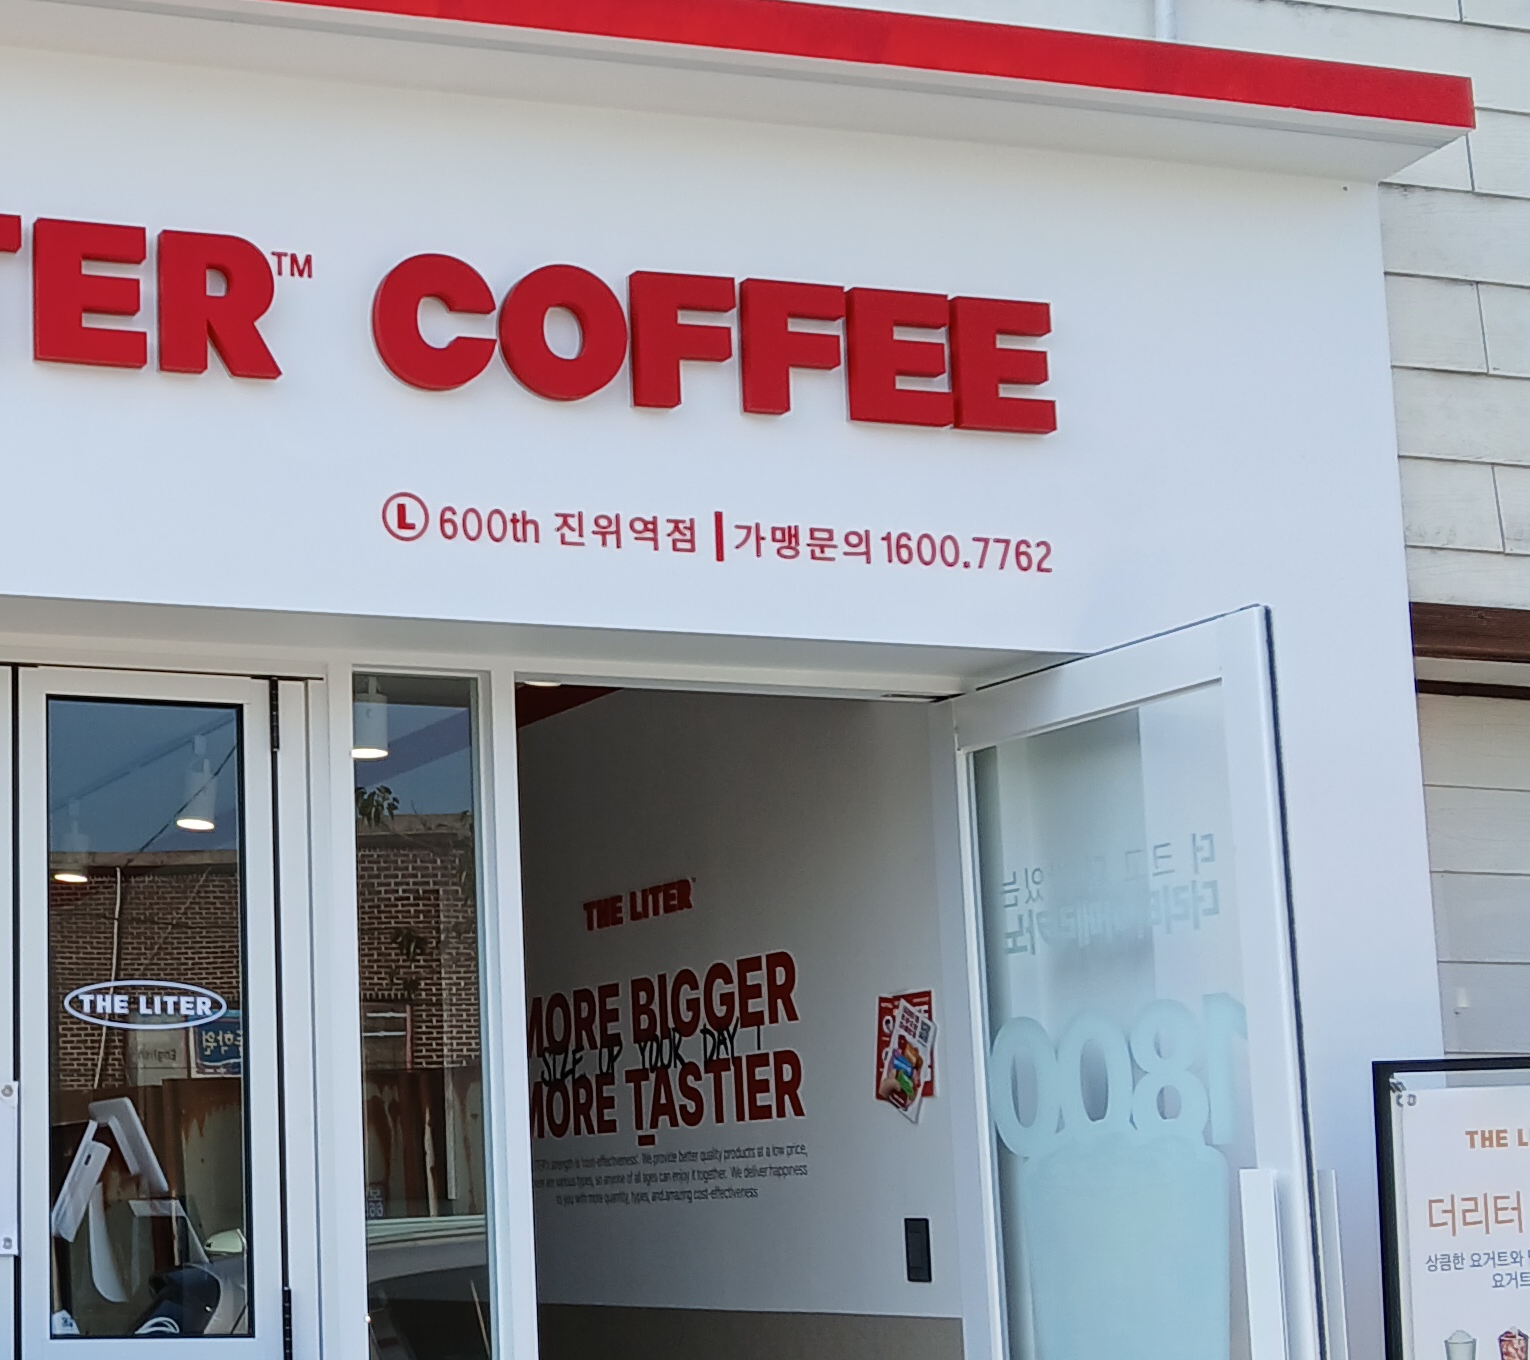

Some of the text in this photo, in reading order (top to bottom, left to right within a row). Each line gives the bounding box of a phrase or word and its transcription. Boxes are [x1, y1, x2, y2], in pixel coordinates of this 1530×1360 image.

[371, 252, 1058, 435] COFFEE
[438, 506, 541, 545] 600th
[554, 510, 698, 554] 진위역점
[733, 521, 872, 565] 가맹문의
[879, 531, 1054, 573] 1600.7762
[583, 878, 693, 932] THE LITER
[77, 993, 213, 1016] THE LITER
[630, 950, 800, 1044] BIGGER
[637, 1026, 688, 1073] YOUR
[700, 1017, 740, 1065] DAY
[624, 1049, 806, 1131] TASTIER
[1465, 1129, 1508, 1148] THE
[1428, 1191, 1523, 1237] 더리터
[1425, 1252, 1465, 1272] 상큼한
[1470, 1249, 1524, 1268] 요거트와
